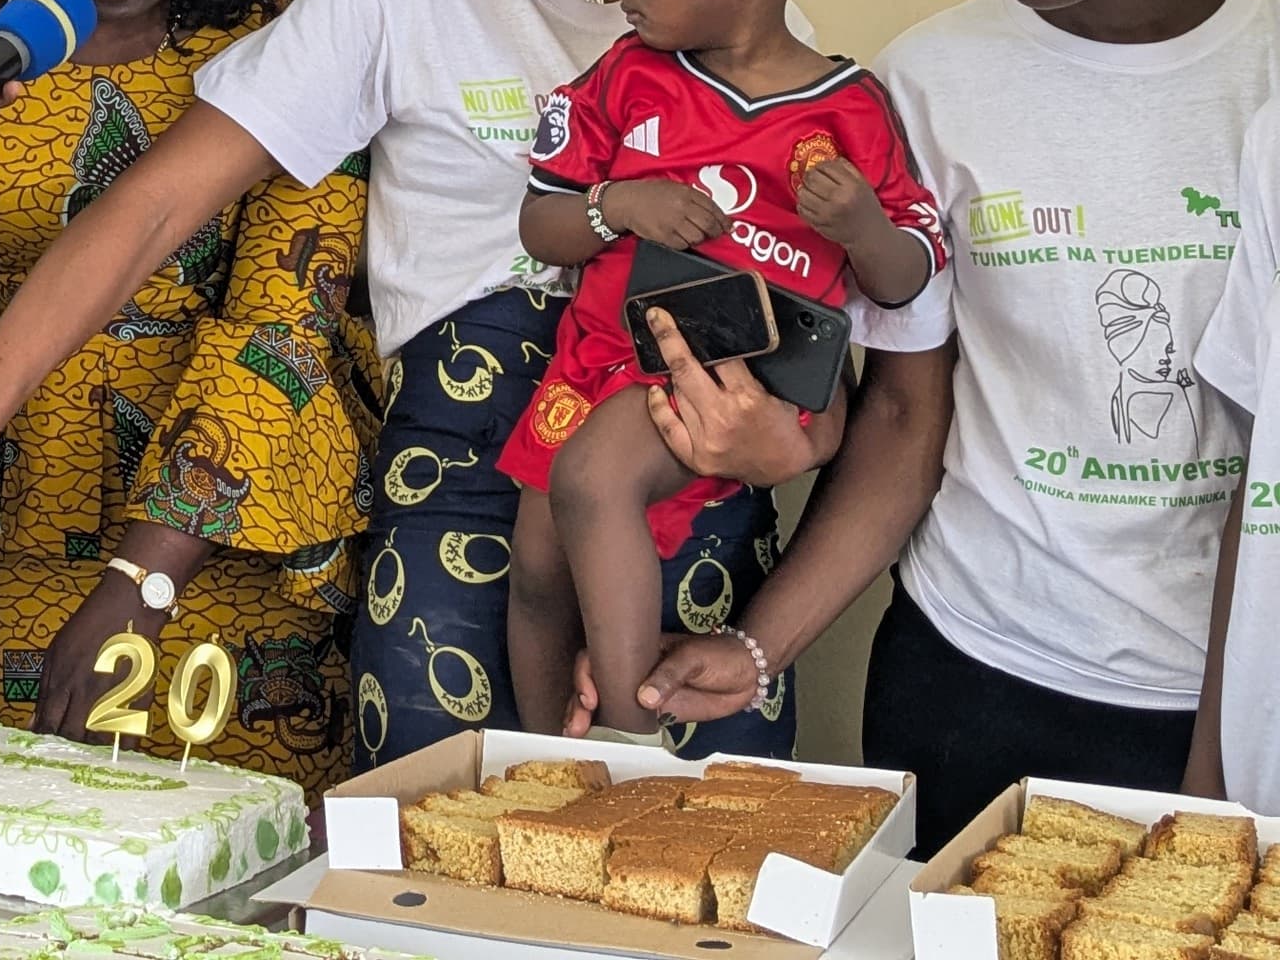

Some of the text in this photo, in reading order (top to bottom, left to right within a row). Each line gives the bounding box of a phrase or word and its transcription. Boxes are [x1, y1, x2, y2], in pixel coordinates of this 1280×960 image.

[463, 89, 489, 113] NO
[491, 86, 530, 112] ONE
[970, 206, 987, 237] NO
[986, 200, 1028, 233] ONE
[970, 246, 1059, 267] TUINUKE
[1067, 246, 1096, 263] NA
[1078, 492, 1157, 507] MWANAMKE
[1160, 490, 1226, 508] TUNAINUKA
[86, 631, 237, 744] 20
